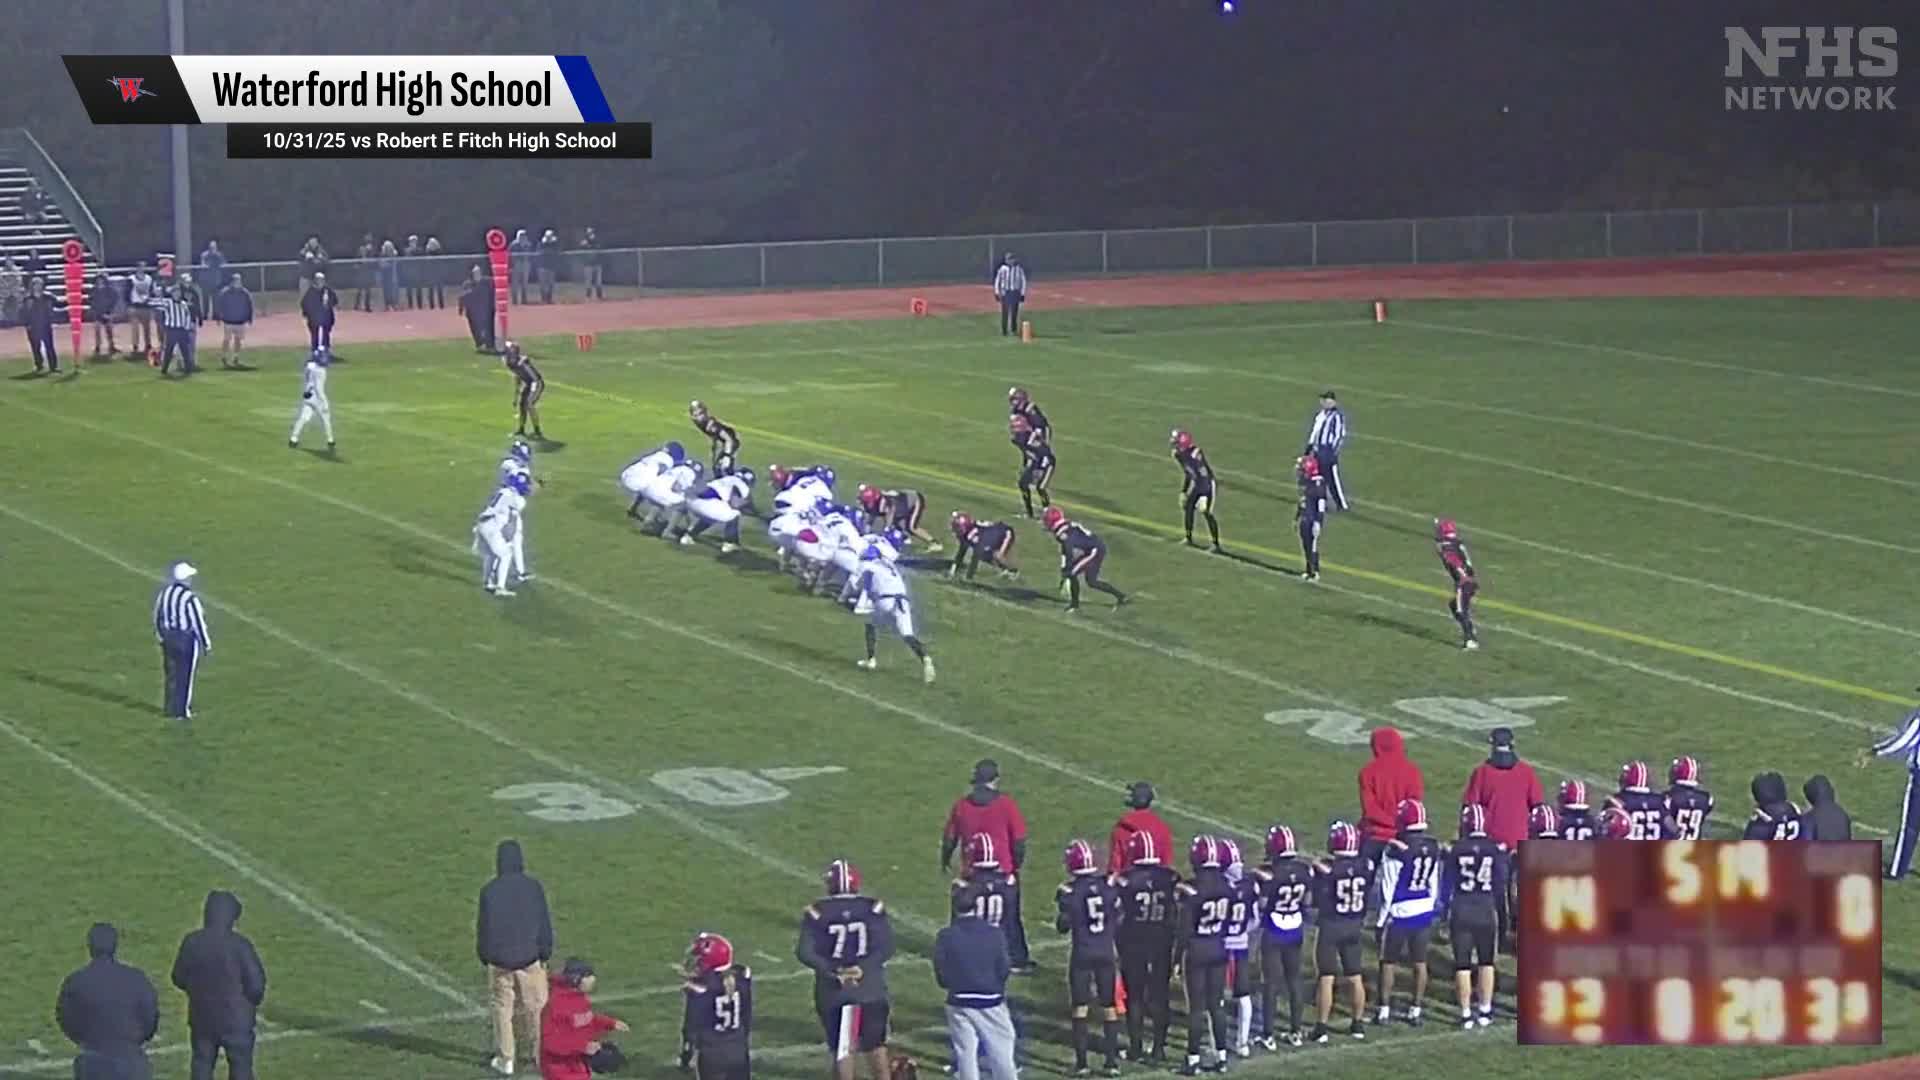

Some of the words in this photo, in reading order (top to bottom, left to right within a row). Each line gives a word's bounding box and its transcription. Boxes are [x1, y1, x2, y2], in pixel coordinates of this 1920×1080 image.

[1408, 856, 1434, 892] 11
[1458, 856, 1494, 892] 54
[1335, 876, 1366, 914] 56
[1086, 896, 1105, 934] 5
[828, 922, 868, 959] 77
[715, 990, 741, 1032] 51
